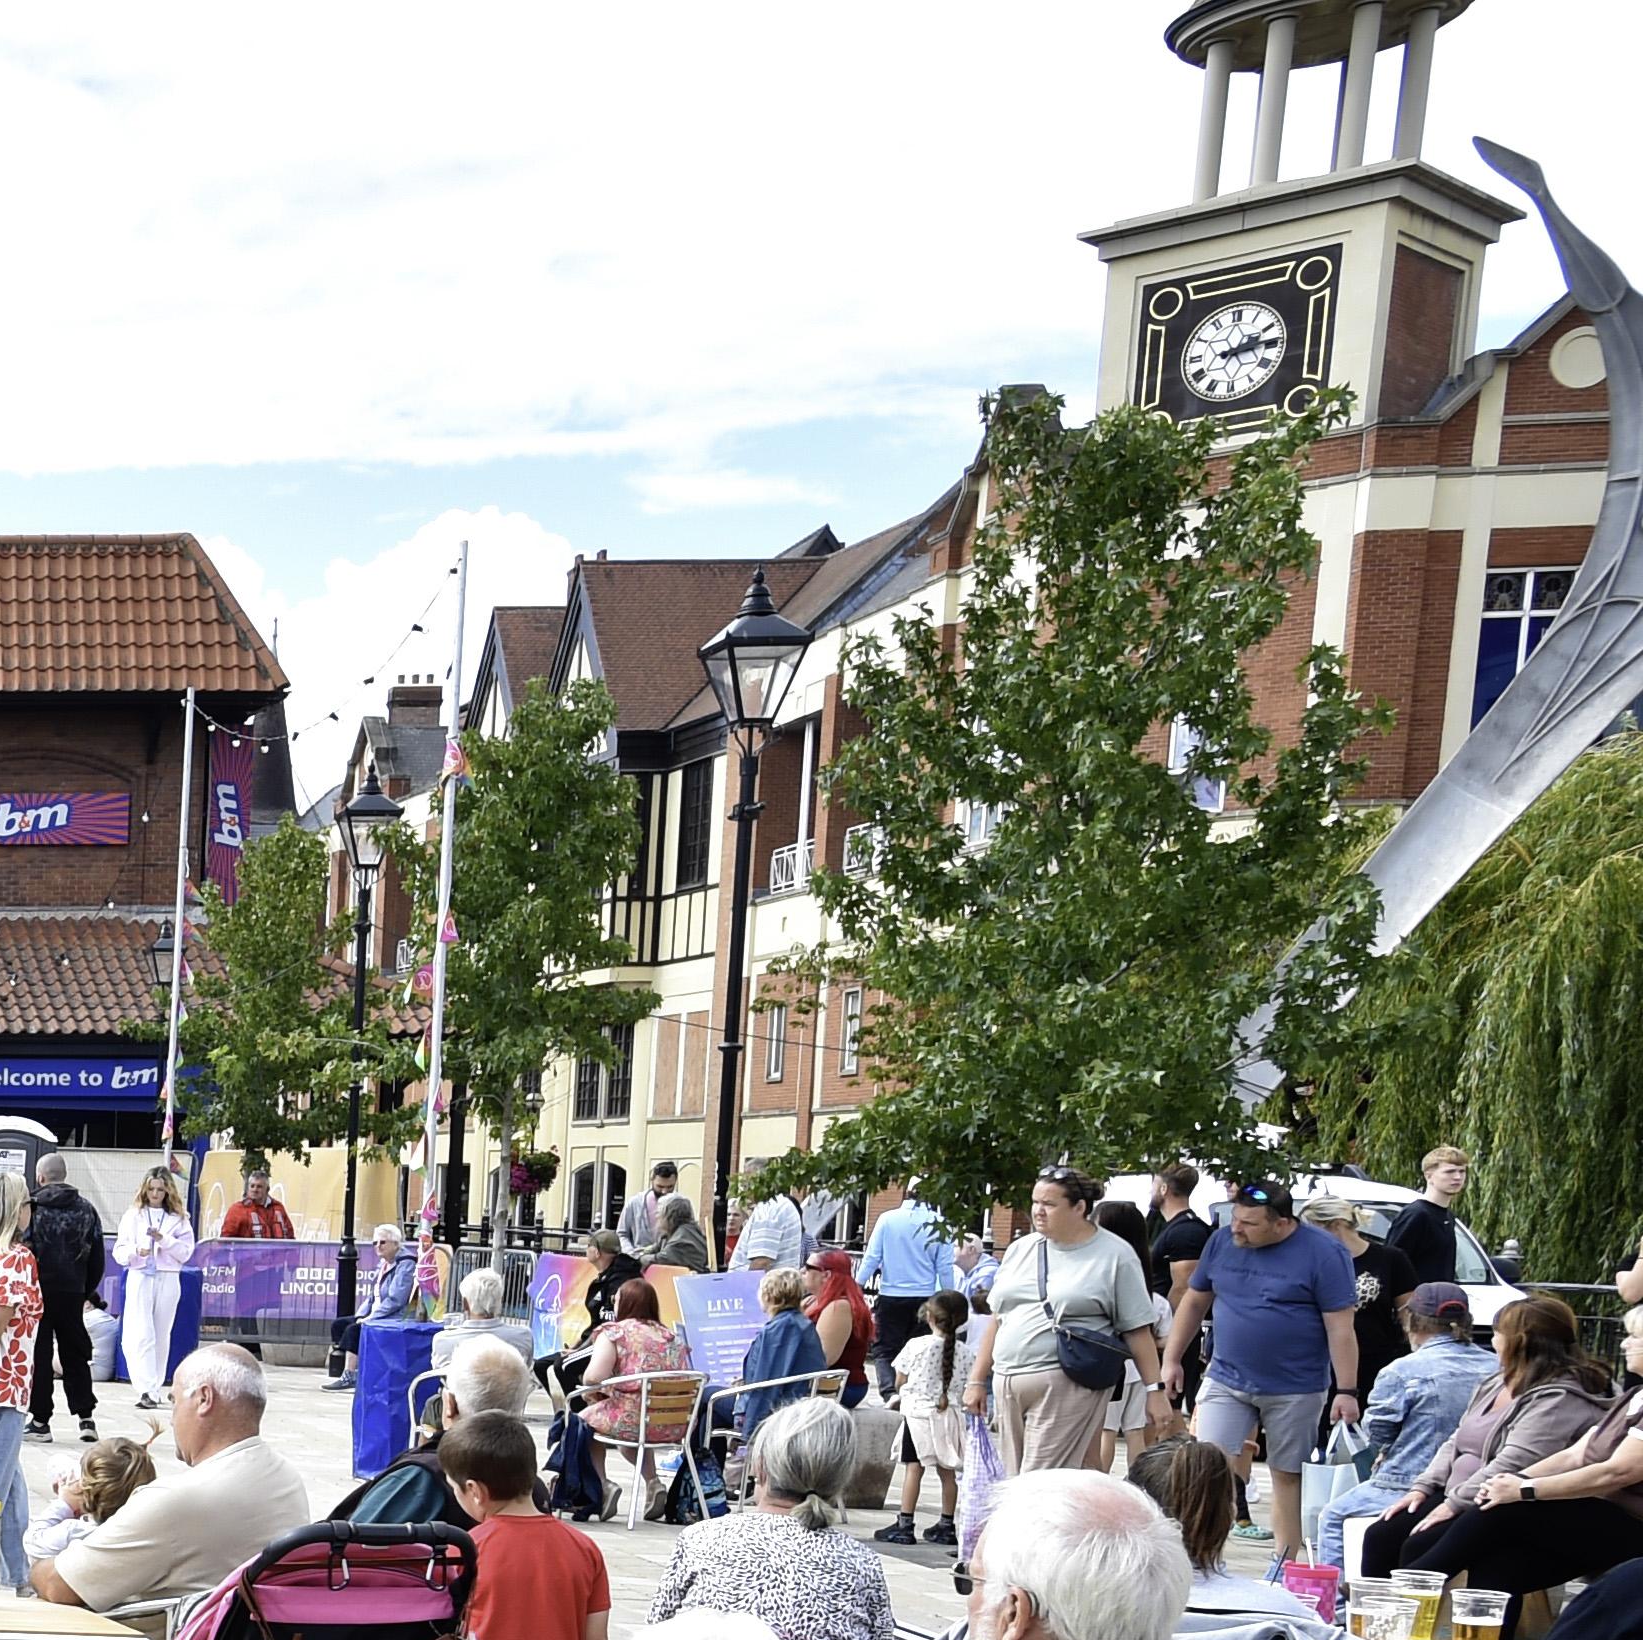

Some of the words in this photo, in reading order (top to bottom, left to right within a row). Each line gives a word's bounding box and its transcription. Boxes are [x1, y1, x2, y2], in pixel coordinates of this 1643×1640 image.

[213, 783, 243, 847] b&m
[78, 1069, 103, 1087] to
[110, 1065, 158, 1090] b&m
[296, 1267, 336, 1281] BBC
[202, 1282, 236, 1294] Radio
[707, 1297, 744, 1312] LIVE
